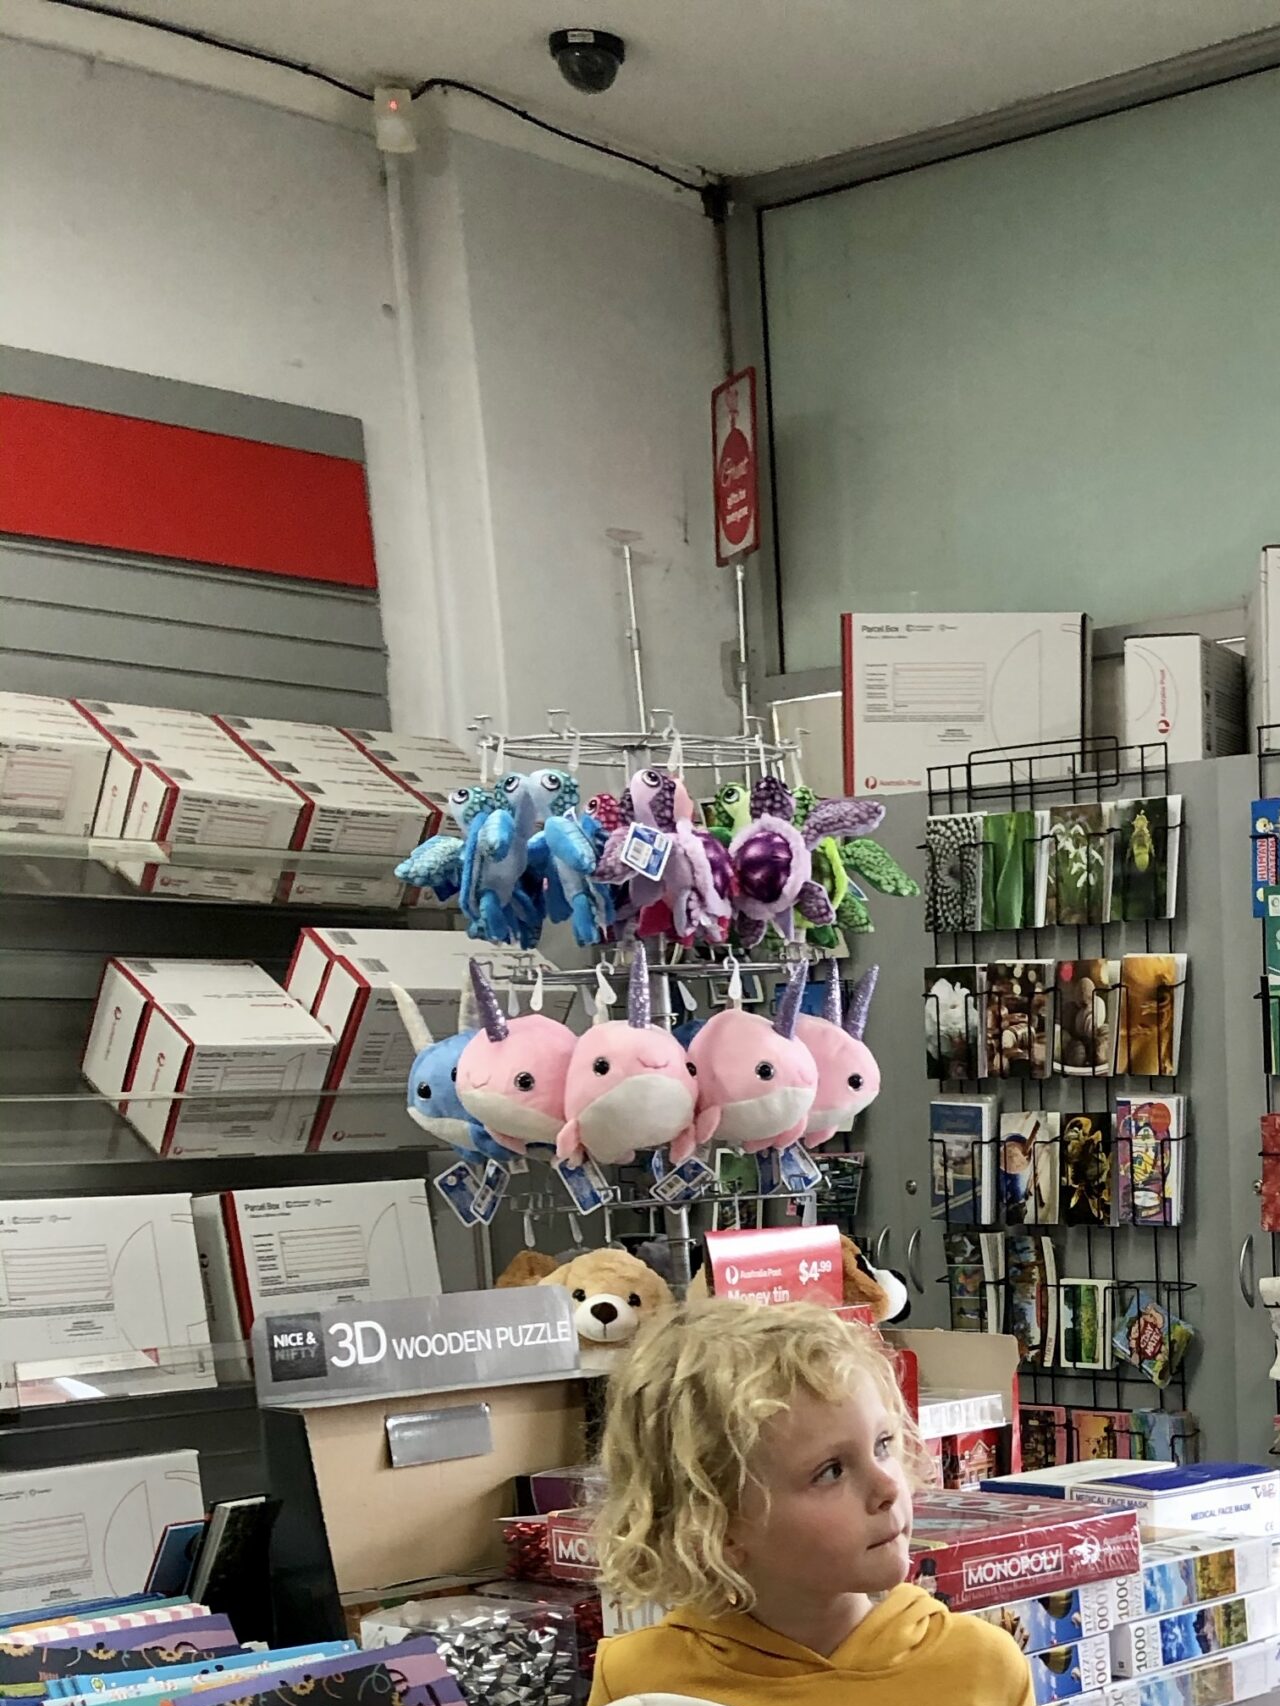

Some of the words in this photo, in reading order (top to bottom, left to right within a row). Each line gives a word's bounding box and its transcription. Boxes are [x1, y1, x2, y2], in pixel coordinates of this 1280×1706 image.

[861, 624, 885, 633] Parcel
[886, 624, 900, 633] Box
[1257, 838, 1268, 881] HUMAN
[244, 1202, 266, 1212] Parcel
[266, 1202, 280, 1210] Box
[727, 1288, 770, 1306] Money
[773, 1286, 790, 1302] tin
[273, 1332, 304, 1348] NICE
[306, 1331, 317, 1346] &
[328, 1320, 388, 1368] 3D
[392, 1328, 492, 1361] WOODEN
[496, 1320, 572, 1349] PUZZLE
[274, 1346, 317, 1362] NIFTY
[1075, 1493, 1106, 1505] MEDICAL
[1107, 1496, 1126, 1507] FACE
[1126, 1498, 1149, 1509] MASK
[1190, 1509, 1218, 1521] MEDICAL
[1218, 1506, 1234, 1516] FACE
[1234, 1503, 1252, 1513] MASK
[966, 1547, 1061, 1587] MONOPOLY
[1134, 1626, 1148, 1672] 1000
[1095, 1640, 1108, 1684] 1000
